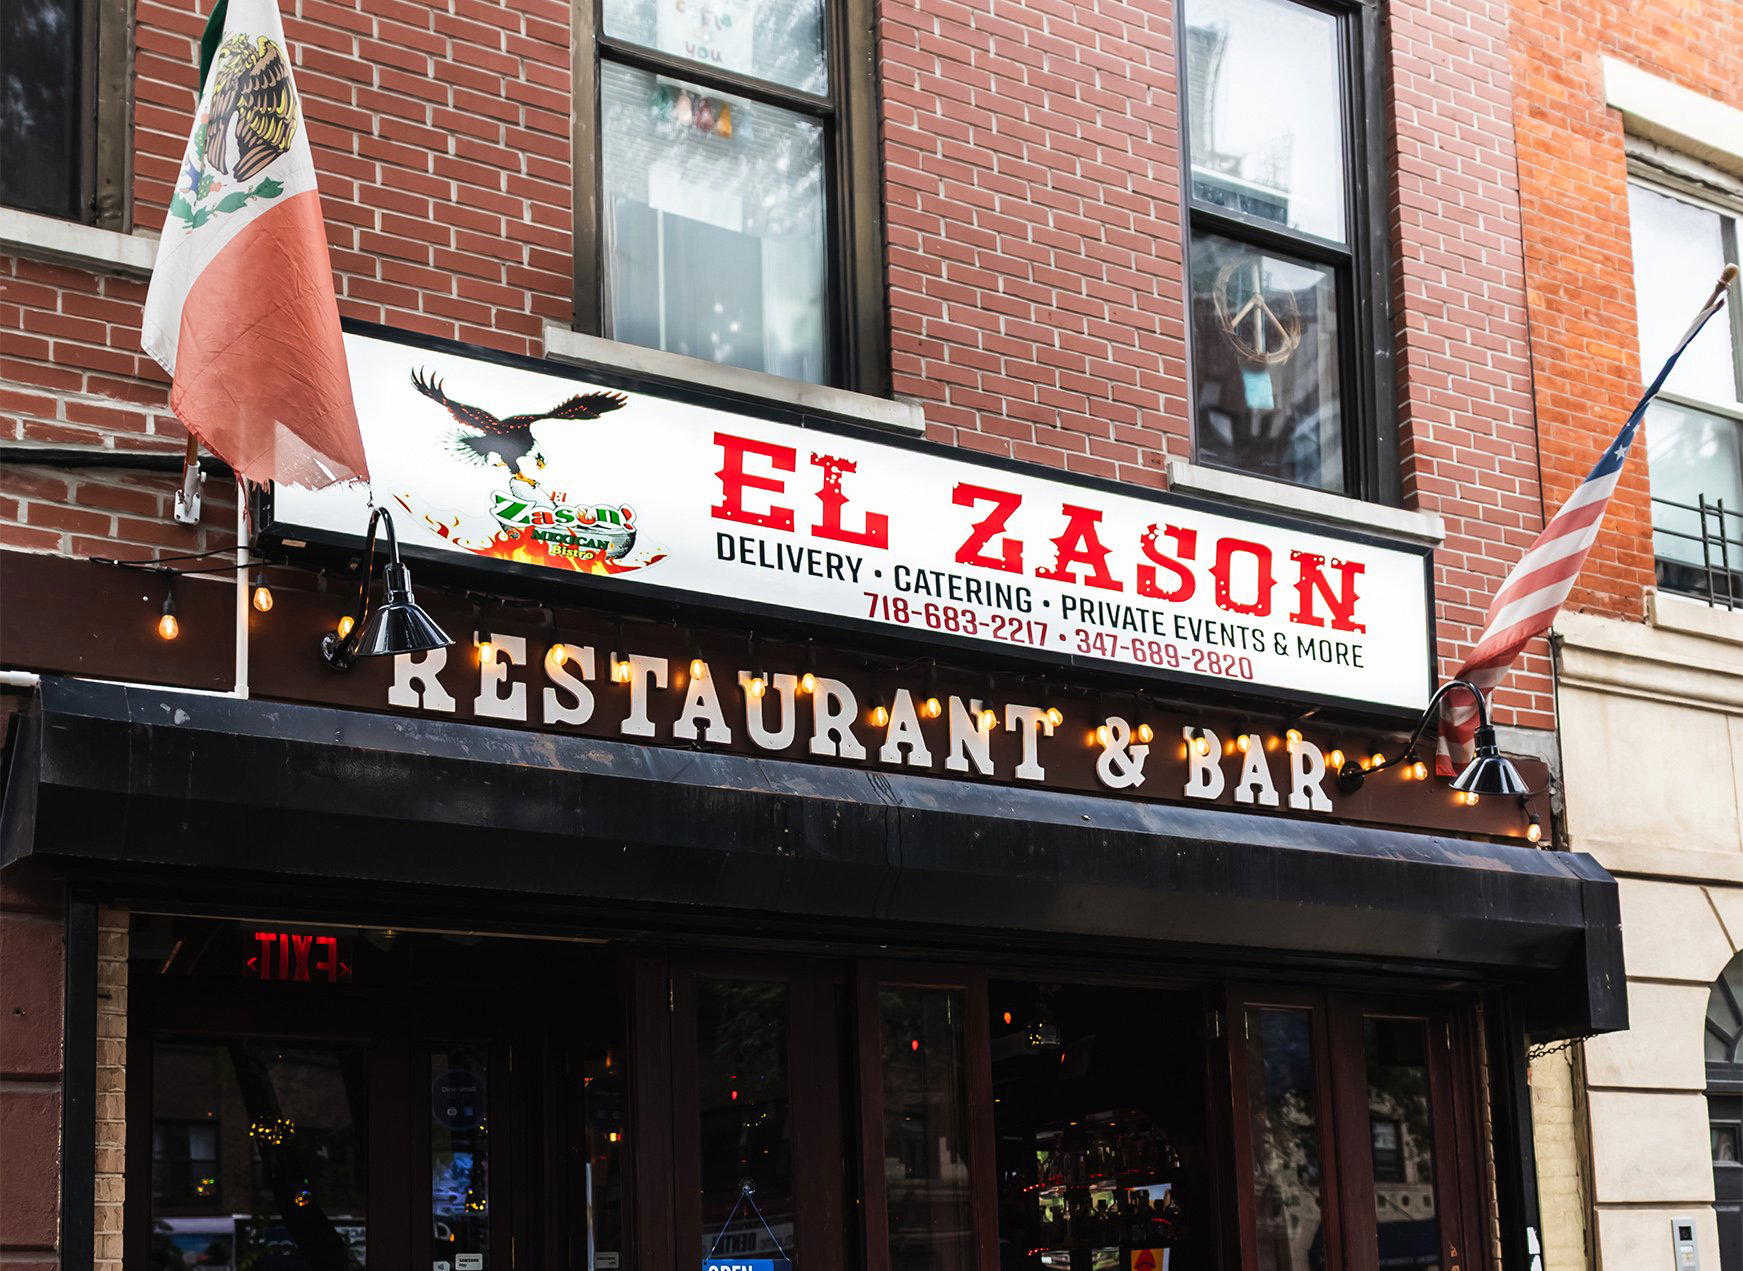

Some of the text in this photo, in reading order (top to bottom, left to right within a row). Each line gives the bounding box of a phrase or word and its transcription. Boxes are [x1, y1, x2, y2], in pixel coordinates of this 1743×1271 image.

[531, 529, 610, 550] MEXICAN
[550, 545, 595, 560] Bistro
[711, 431, 1366, 634] EL ZASON
[716, 532, 1364, 669] DELIVERY CATERING PRIVATE EVENTS & MORE
[863, 591, 1254, 680] 718-683-2217 347-689-2820
[388, 631, 1333, 812] RESTAURANT & BAR
